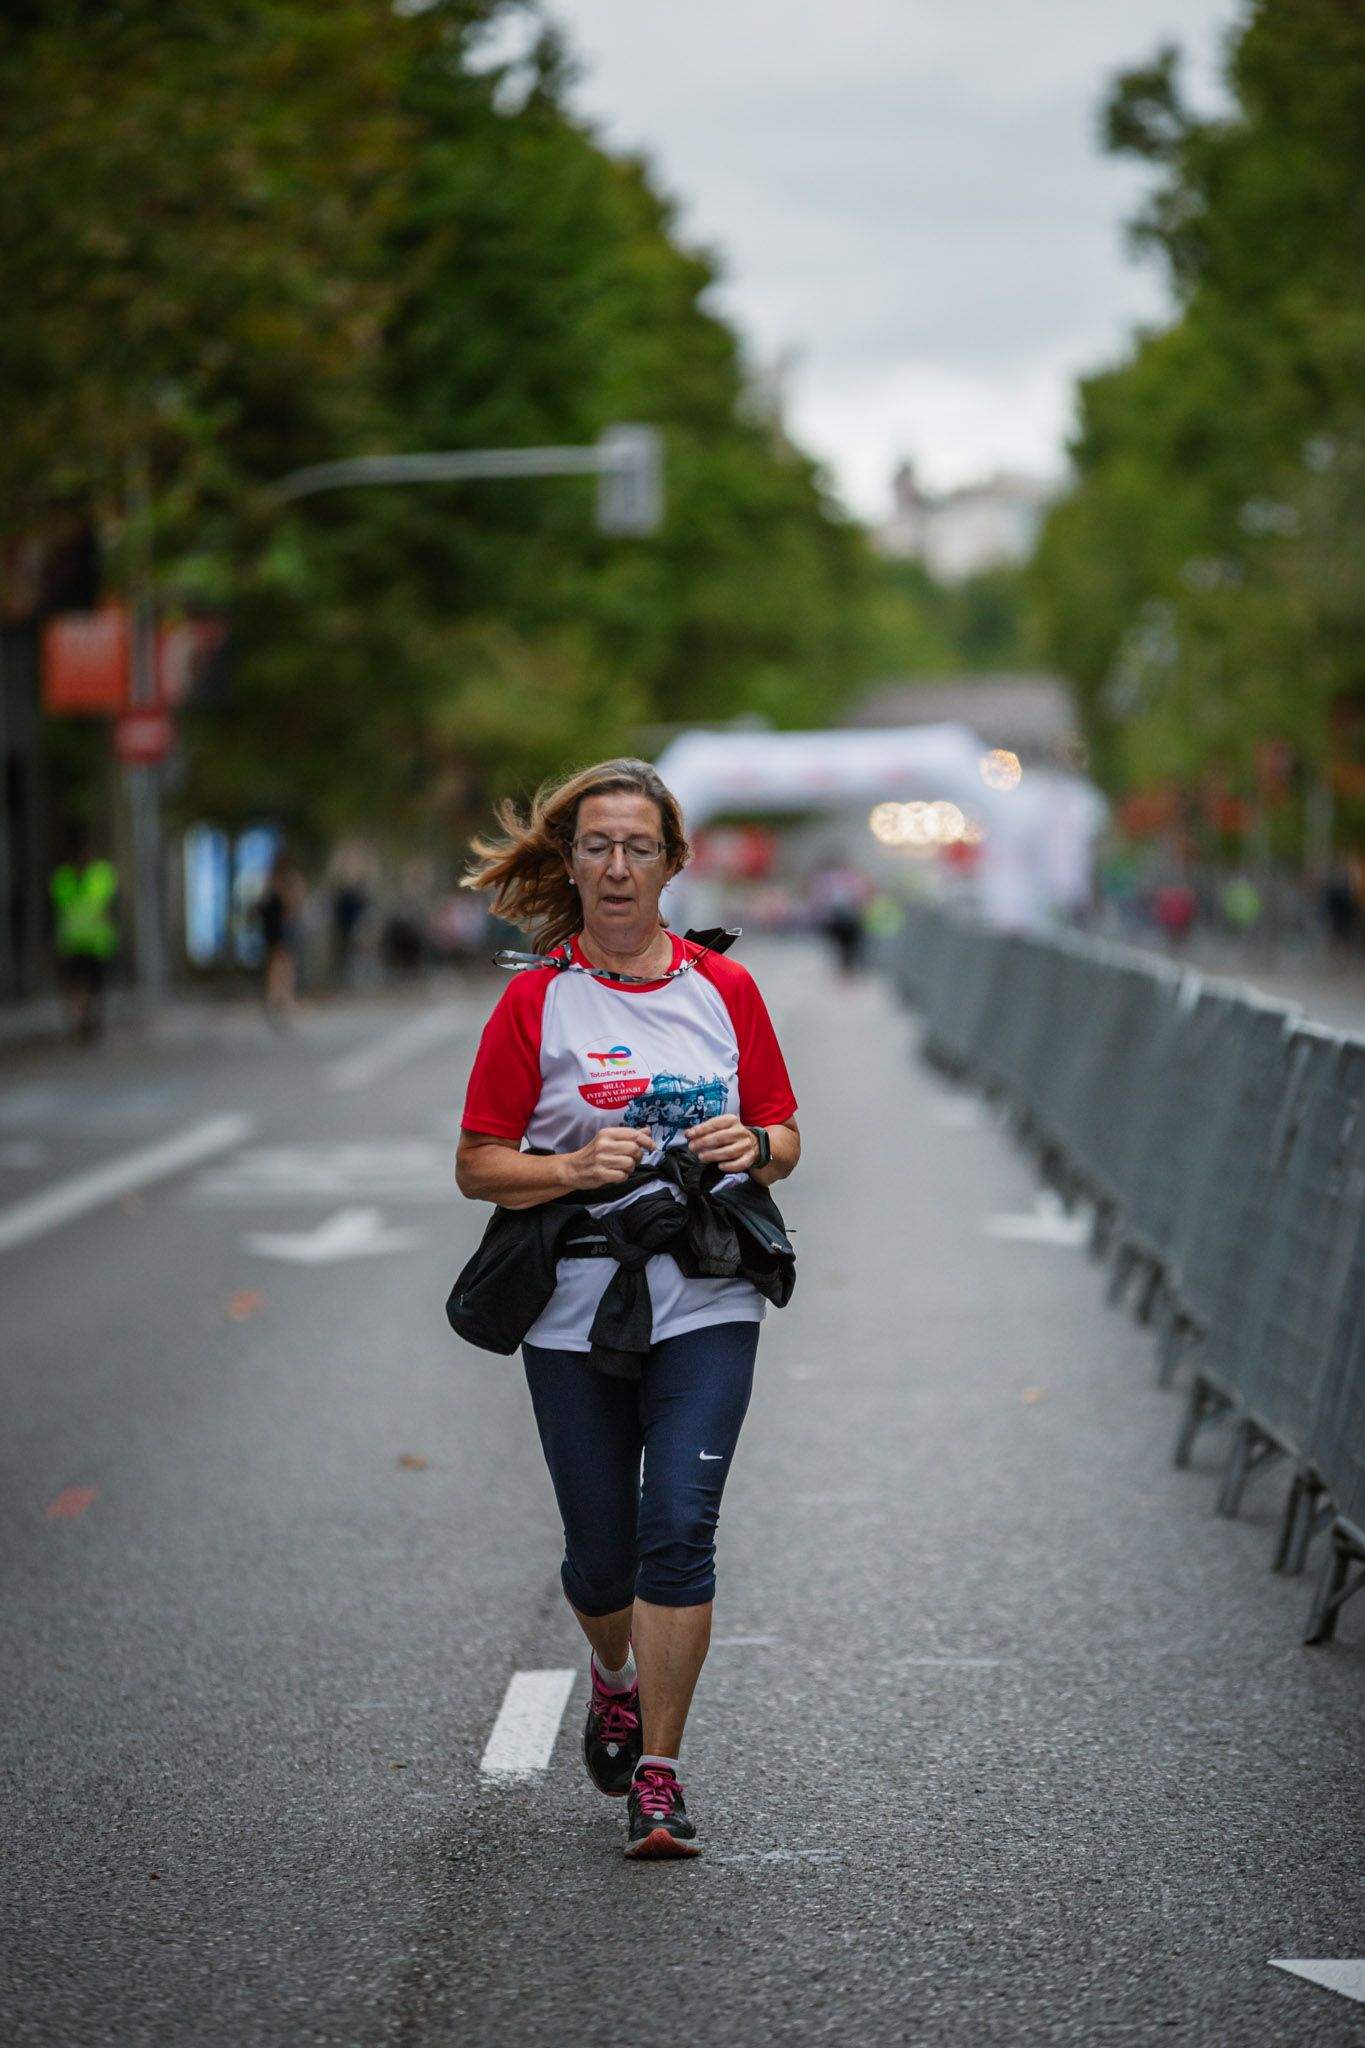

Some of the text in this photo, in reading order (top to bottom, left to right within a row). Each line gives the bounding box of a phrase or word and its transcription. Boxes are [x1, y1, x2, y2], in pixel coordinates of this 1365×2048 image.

[589, 1069, 637, 1078] TotalEnergies
[602, 1082, 625, 1090] MILLA
[586, 1087, 641, 1099] INTERNACIONAL
[607, 1094, 635, 1103] MADRID
